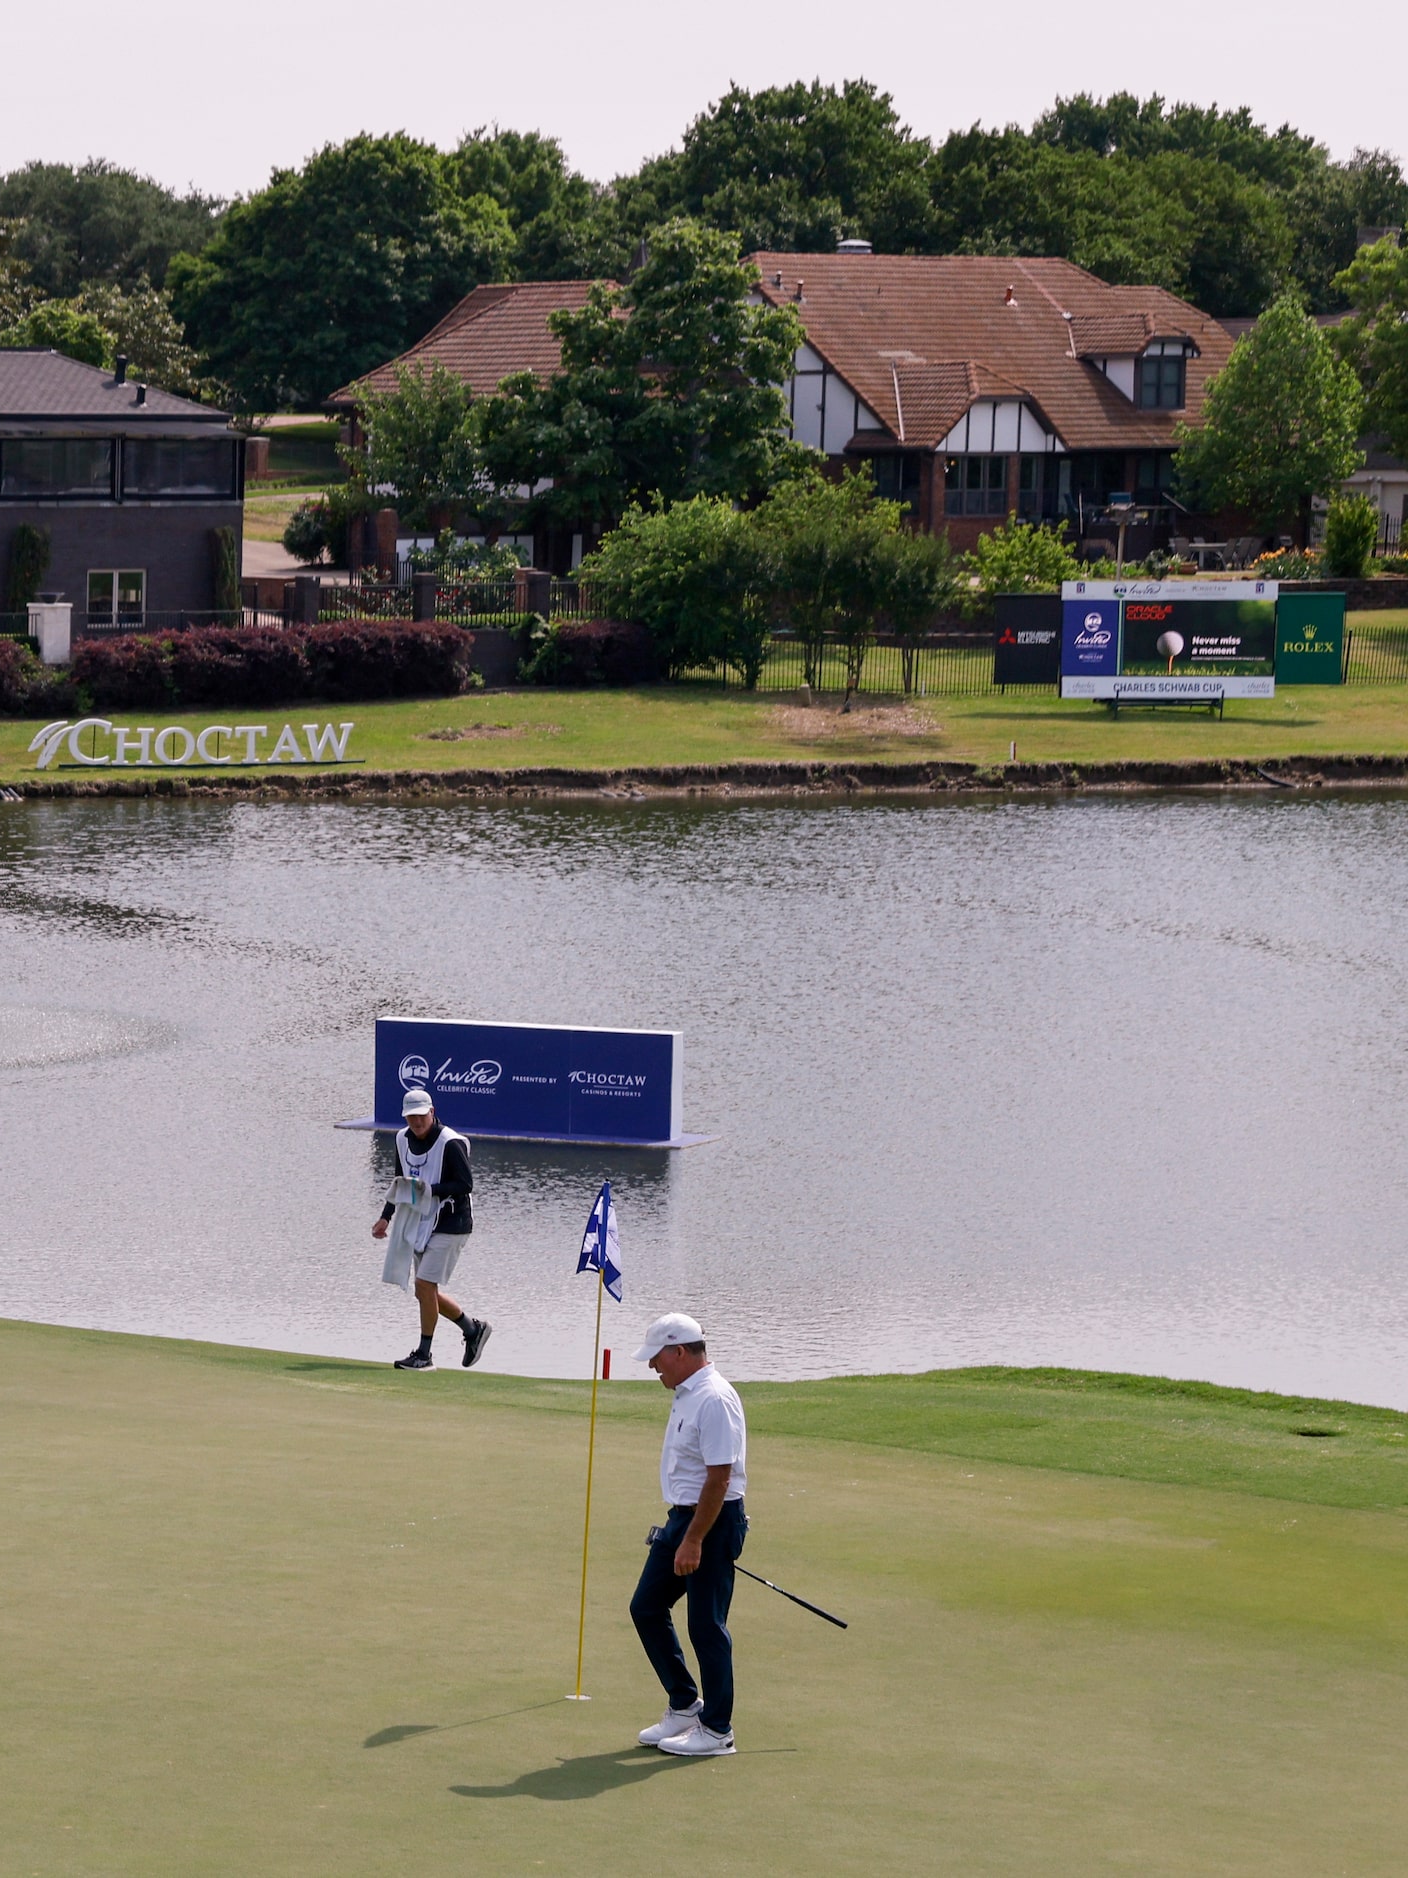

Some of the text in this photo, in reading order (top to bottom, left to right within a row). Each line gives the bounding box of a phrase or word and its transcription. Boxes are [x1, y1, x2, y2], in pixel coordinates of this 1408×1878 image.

[1126, 605, 1172, 613] ORACLE
[1192, 635, 1242, 645] Never miss
[1199, 647, 1237, 655] moment
[1284, 641, 1334, 653] ROLEX
[1113, 683, 1223, 693] CHARLES SCHWAB CUP
[67, 718, 355, 765] CHOCTAW
[433, 1058, 502, 1085] Invited
[512, 1075, 548, 1084] PRESENTED
[575, 1070, 647, 1087] CHOCTAW
[437, 1085, 497, 1095] CELEBRITY CLASSIC
[581, 1088, 608, 1096] CASINOS
